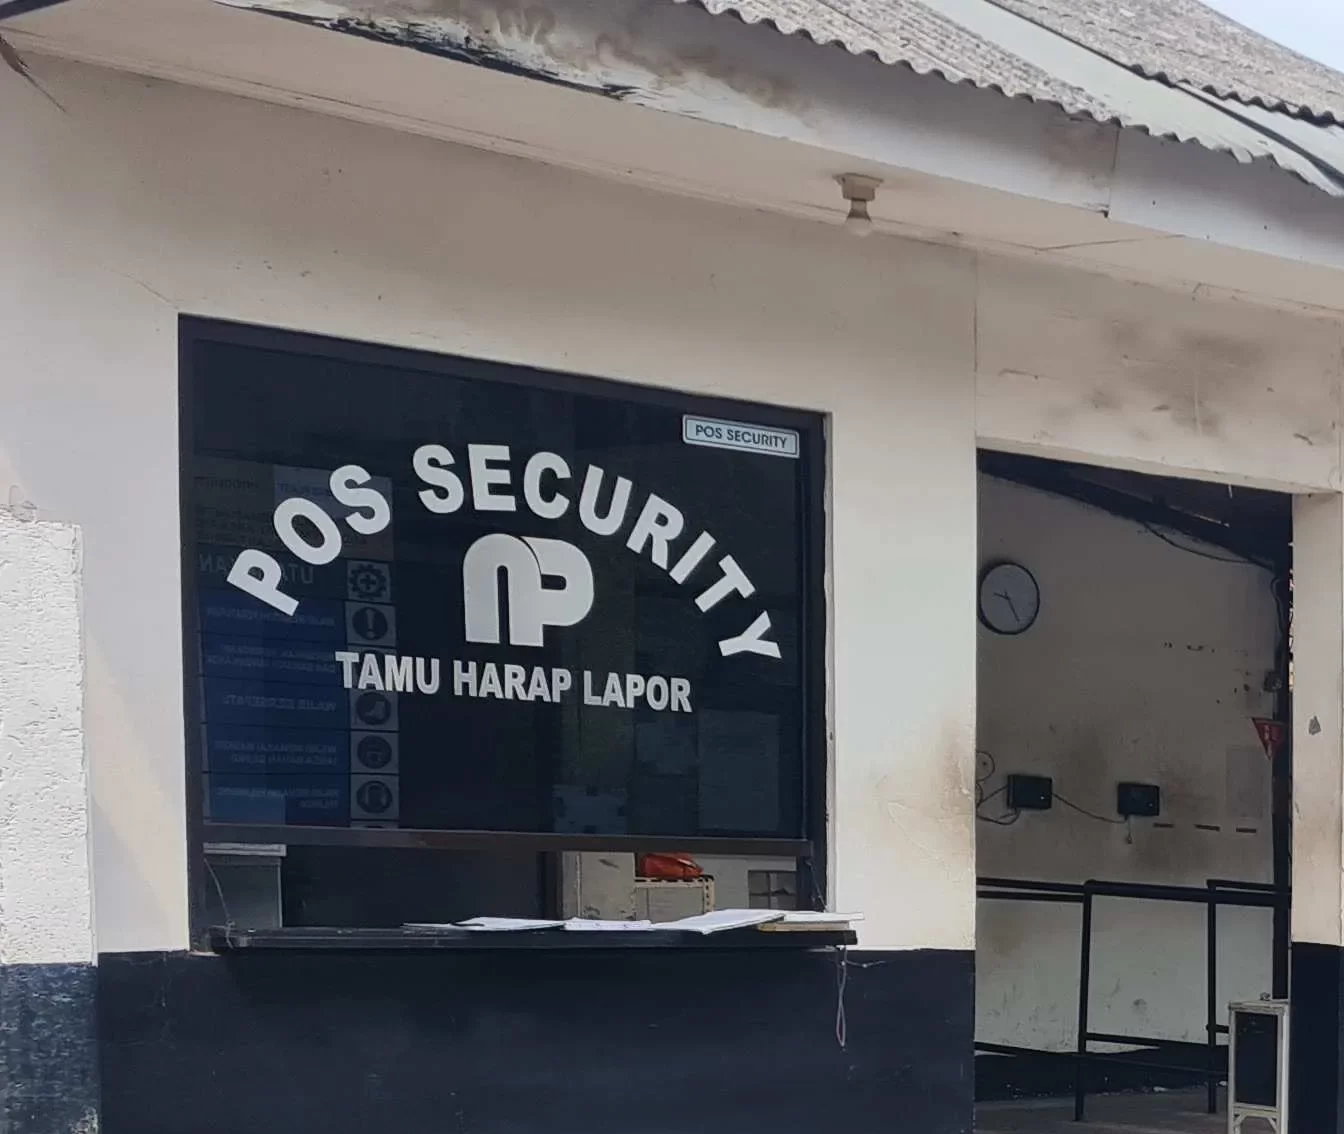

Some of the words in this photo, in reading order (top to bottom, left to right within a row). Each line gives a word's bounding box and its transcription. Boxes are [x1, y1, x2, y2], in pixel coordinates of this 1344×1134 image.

[695, 424, 722, 439] POS
[727, 429, 787, 448] SECURITY
[226, 464, 391, 616] POS
[412, 443, 782, 659] SECURITY
[335, 651, 440, 695] TAMU
[454, 660, 572, 703] HARAP
[583, 670, 692, 712] LAPOR
